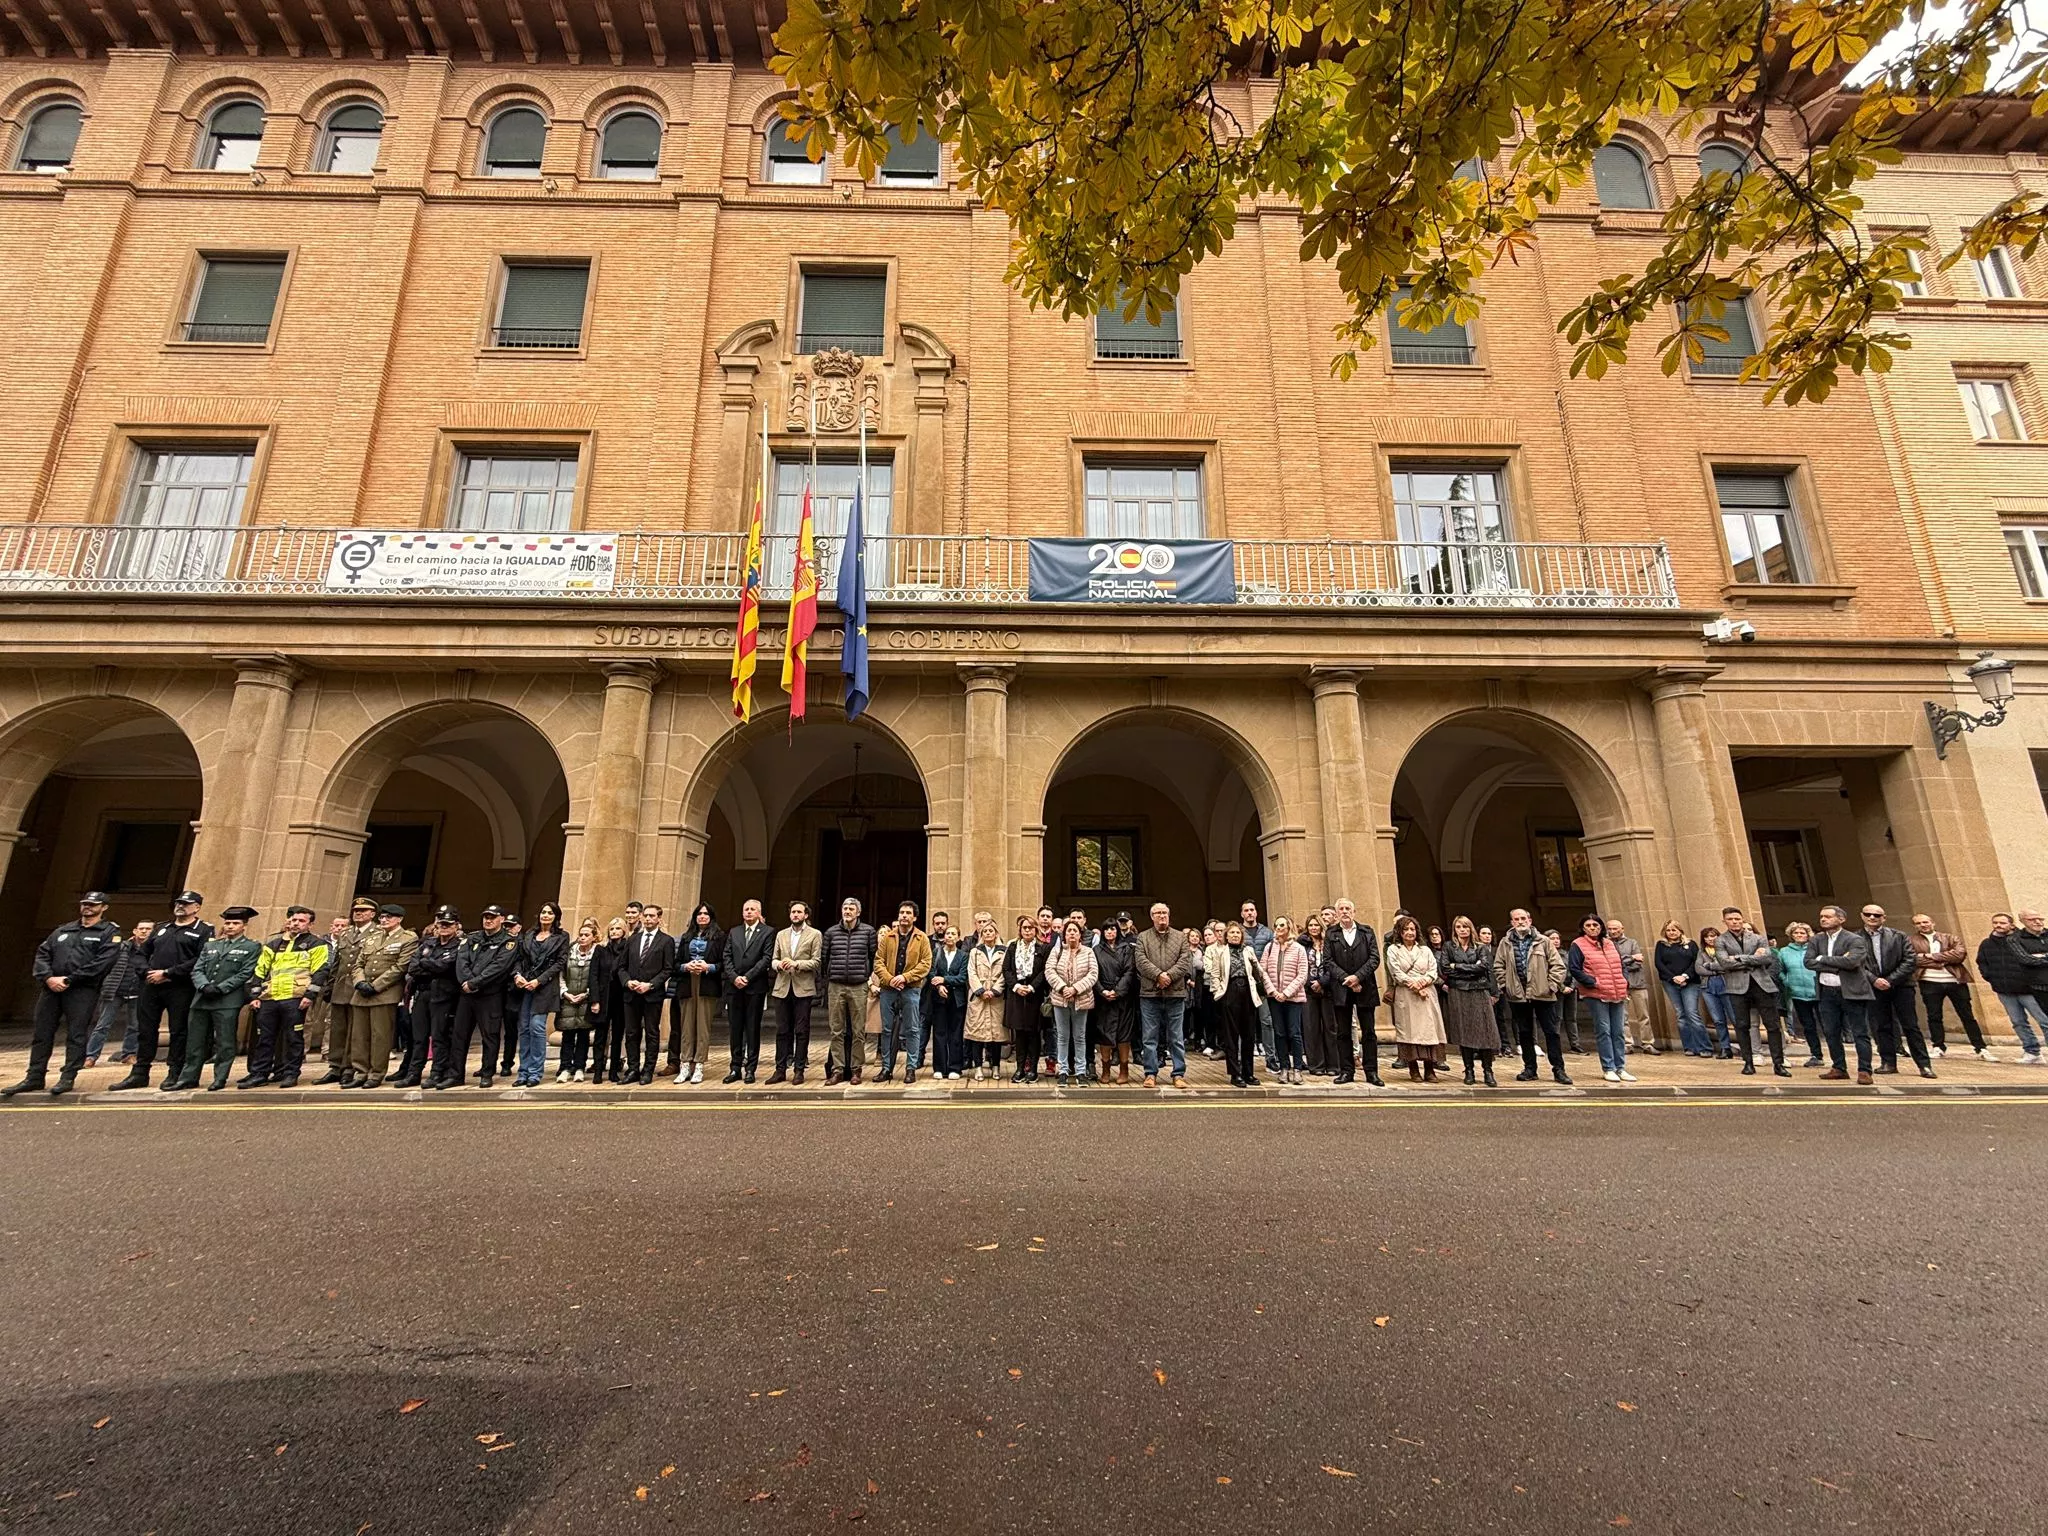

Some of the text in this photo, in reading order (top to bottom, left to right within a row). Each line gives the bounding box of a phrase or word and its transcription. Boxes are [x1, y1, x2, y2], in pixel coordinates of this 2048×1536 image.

[386, 554, 566, 566] En el camino hacia la IGUALDAD
[569, 554, 597, 572] #016
[1088, 541, 1175, 575] 200
[429, 566, 518, 577] ni un paso atrás
[1088, 579, 1159, 589] POLICIA
[1088, 589, 1177, 599] NACIONAL
[594, 624, 814, 649] SUBDELEGCIO
[887, 629, 1022, 650] GOBIERNO
